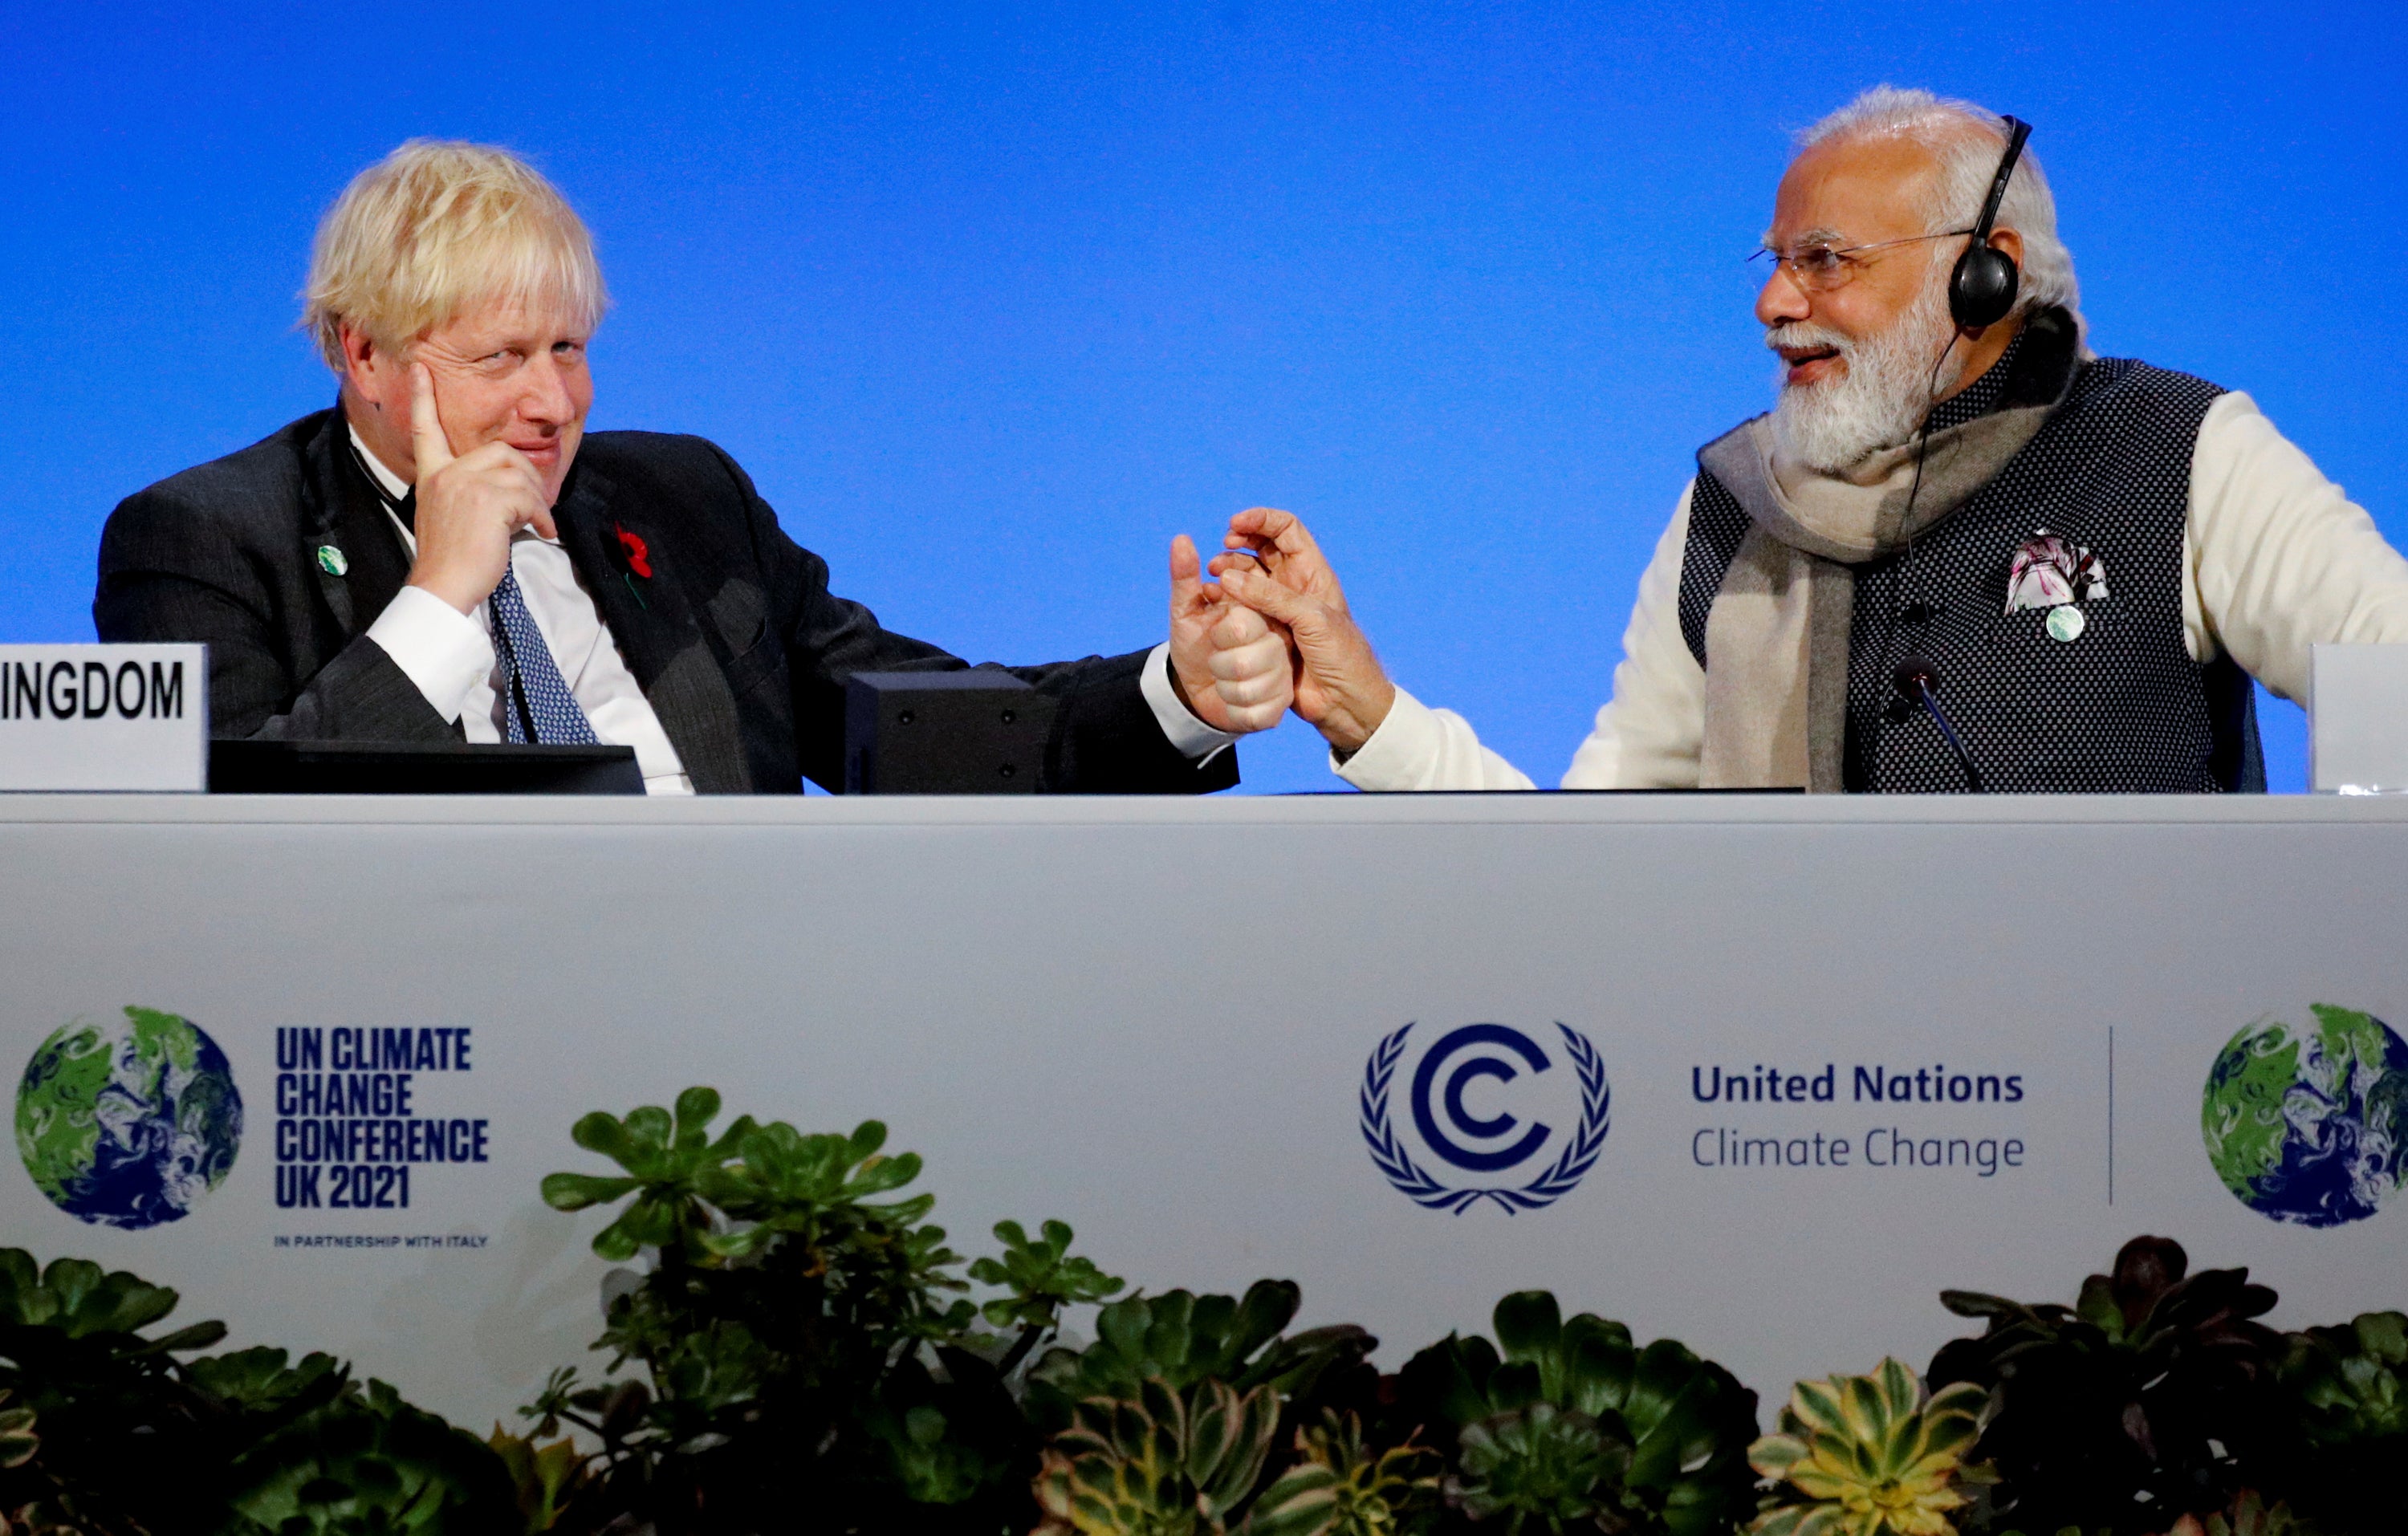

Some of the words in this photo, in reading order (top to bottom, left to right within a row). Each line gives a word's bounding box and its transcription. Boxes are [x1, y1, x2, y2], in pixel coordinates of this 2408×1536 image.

[276, 1026, 323, 1071] UN
[330, 1026, 472, 1071] CLIMATE
[276, 1072, 413, 1118] CHANGE
[1692, 1064, 1835, 1103] United
[1853, 1064, 2024, 1103] Nations
[275, 1118, 489, 1164] CONFERENCE
[1691, 1128, 1851, 1168] Climate
[1864, 1128, 2025, 1177] Change
[275, 1164, 323, 1209] UK
[329, 1164, 410, 1209] 2021
[275, 1235, 290, 1248] IN
[294, 1235, 401, 1248] PARTNERSHIP
[405, 1235, 442, 1248] WITH
[446, 1235, 487, 1248] ITALY
